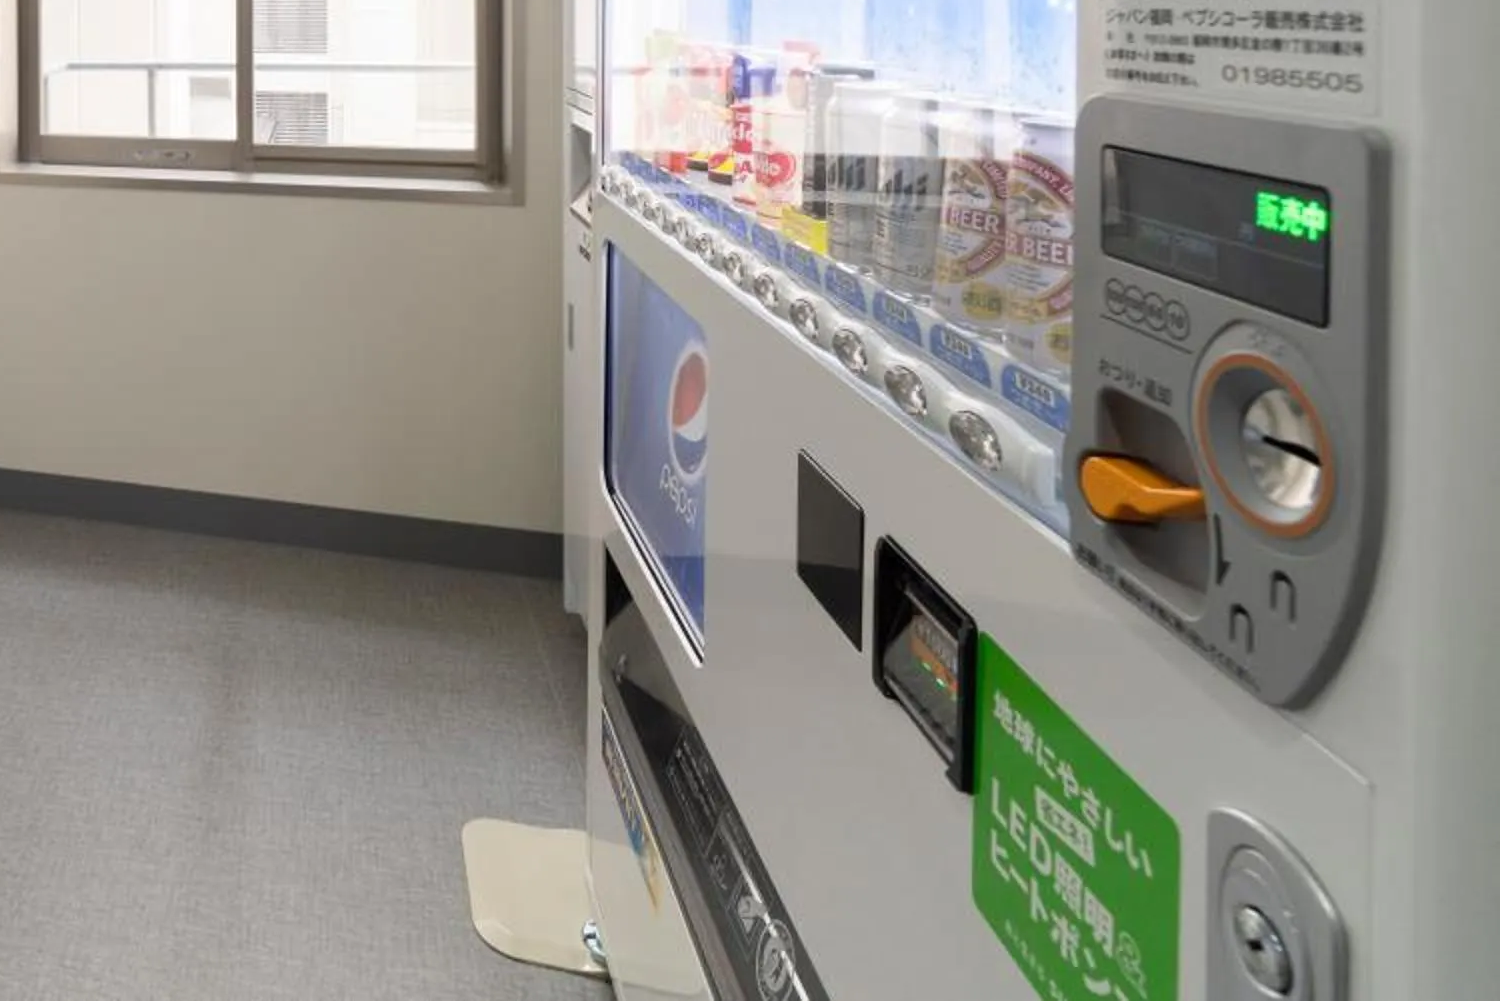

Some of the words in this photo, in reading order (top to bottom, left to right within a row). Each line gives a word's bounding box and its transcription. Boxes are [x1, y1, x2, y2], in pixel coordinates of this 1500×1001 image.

[1221, 64, 1364, 93] 01985505
[950, 207, 1000, 235] BEER
[1256, 191, 1327, 242] 販売中
[993, 689, 1153, 878] 地球にやさしい
[991, 776, 1113, 958] LED照明
[991, 828, 1134, 1001] ヒートポン
